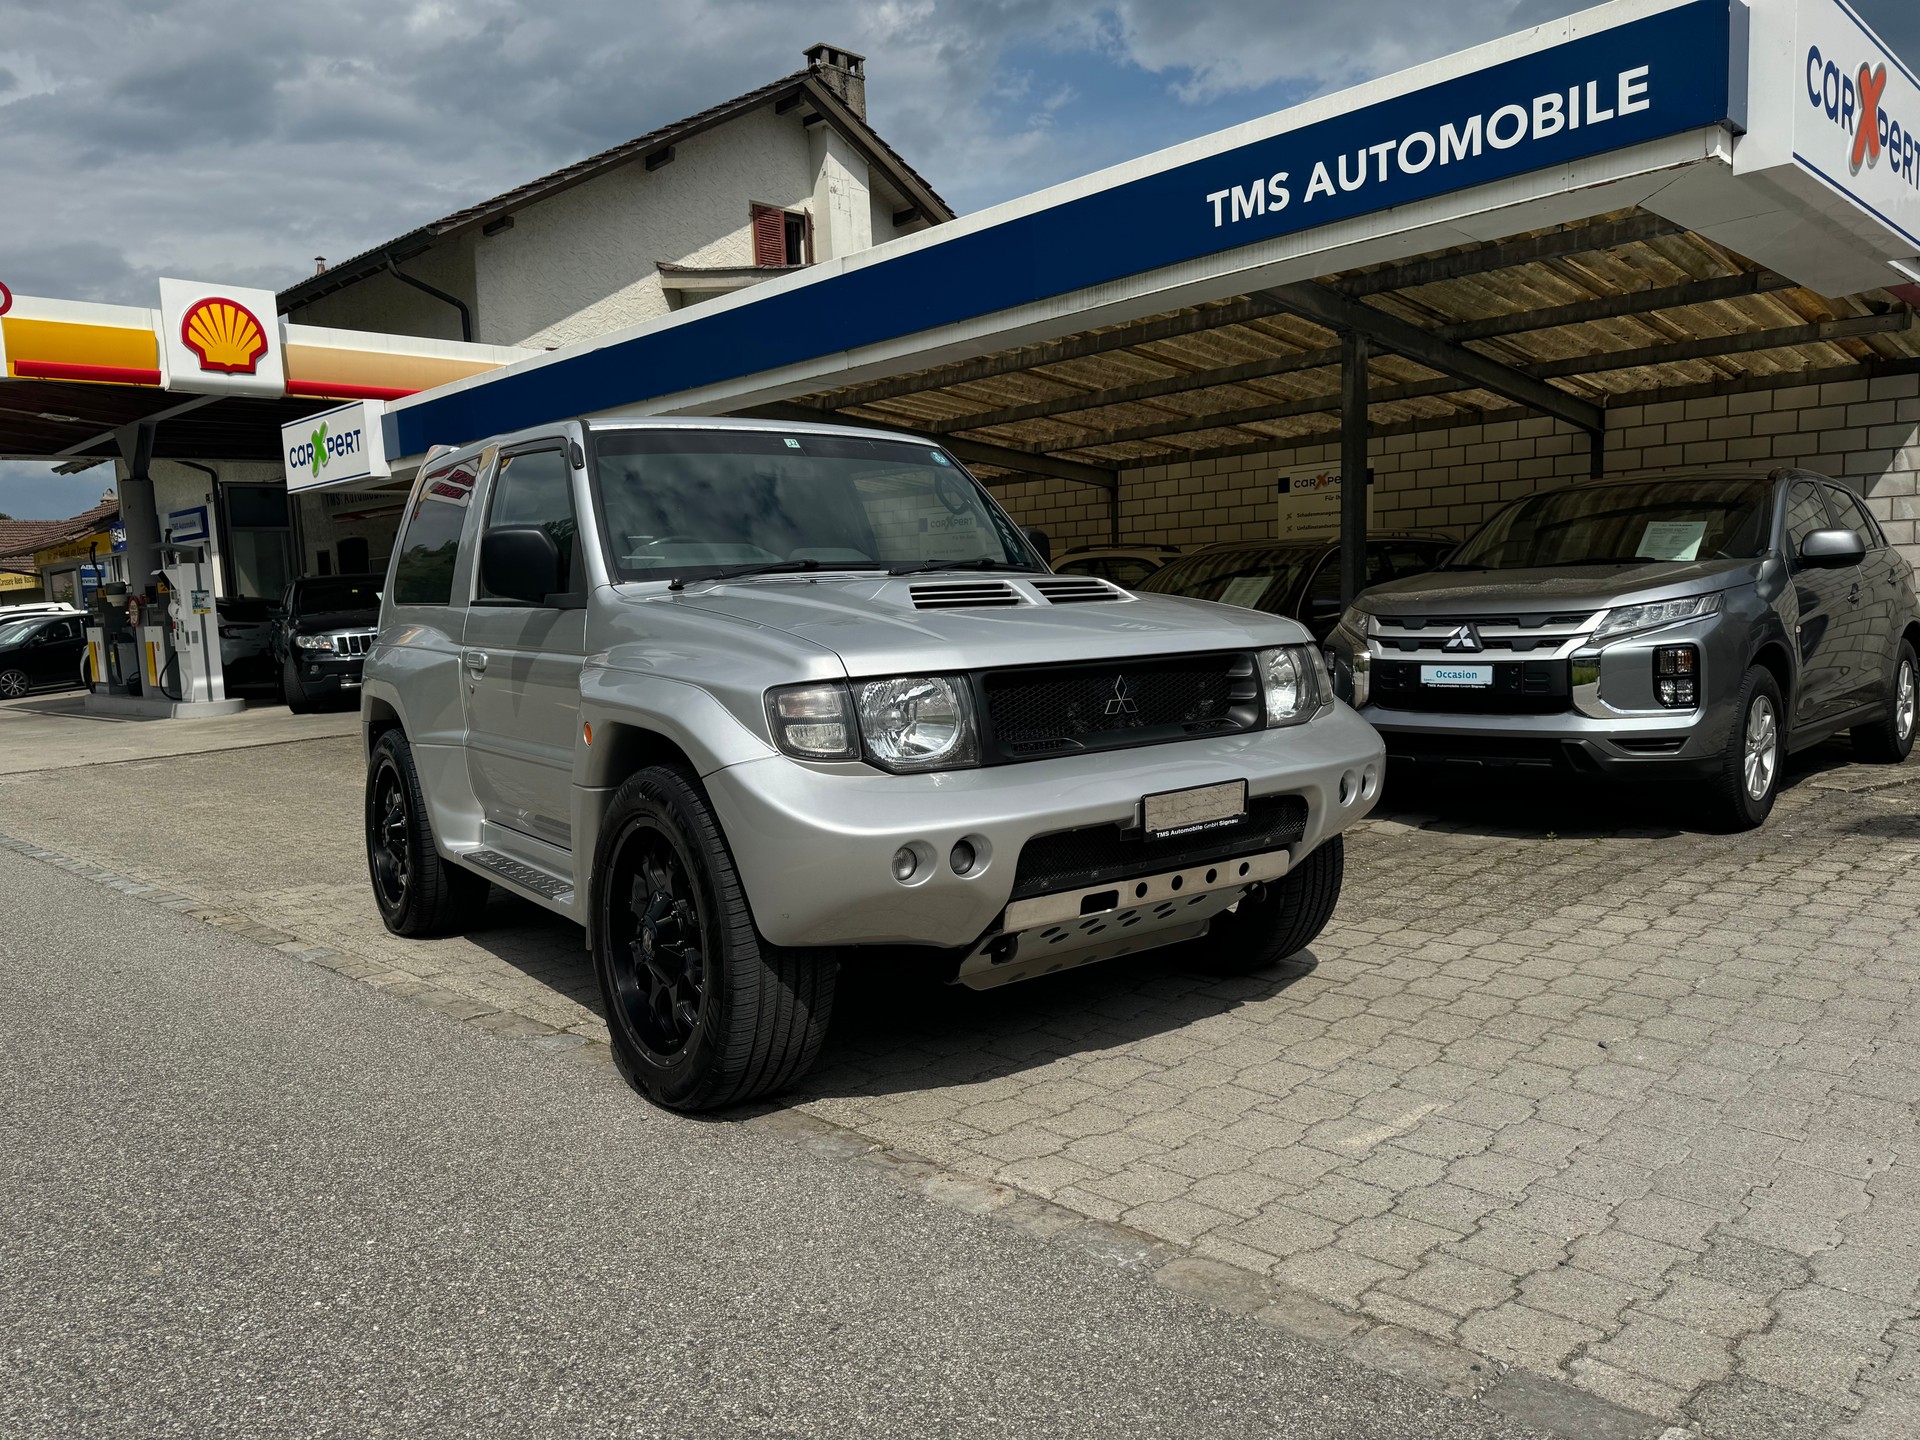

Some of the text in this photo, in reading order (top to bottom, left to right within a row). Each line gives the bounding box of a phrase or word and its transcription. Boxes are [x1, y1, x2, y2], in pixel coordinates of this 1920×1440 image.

[1206, 65, 1650, 228] TMS AUTOMOBILE
[326, 493, 340, 507] TMS
[1436, 670, 1477, 679] Occasion
[1170, 825, 1203, 836] Automobile
